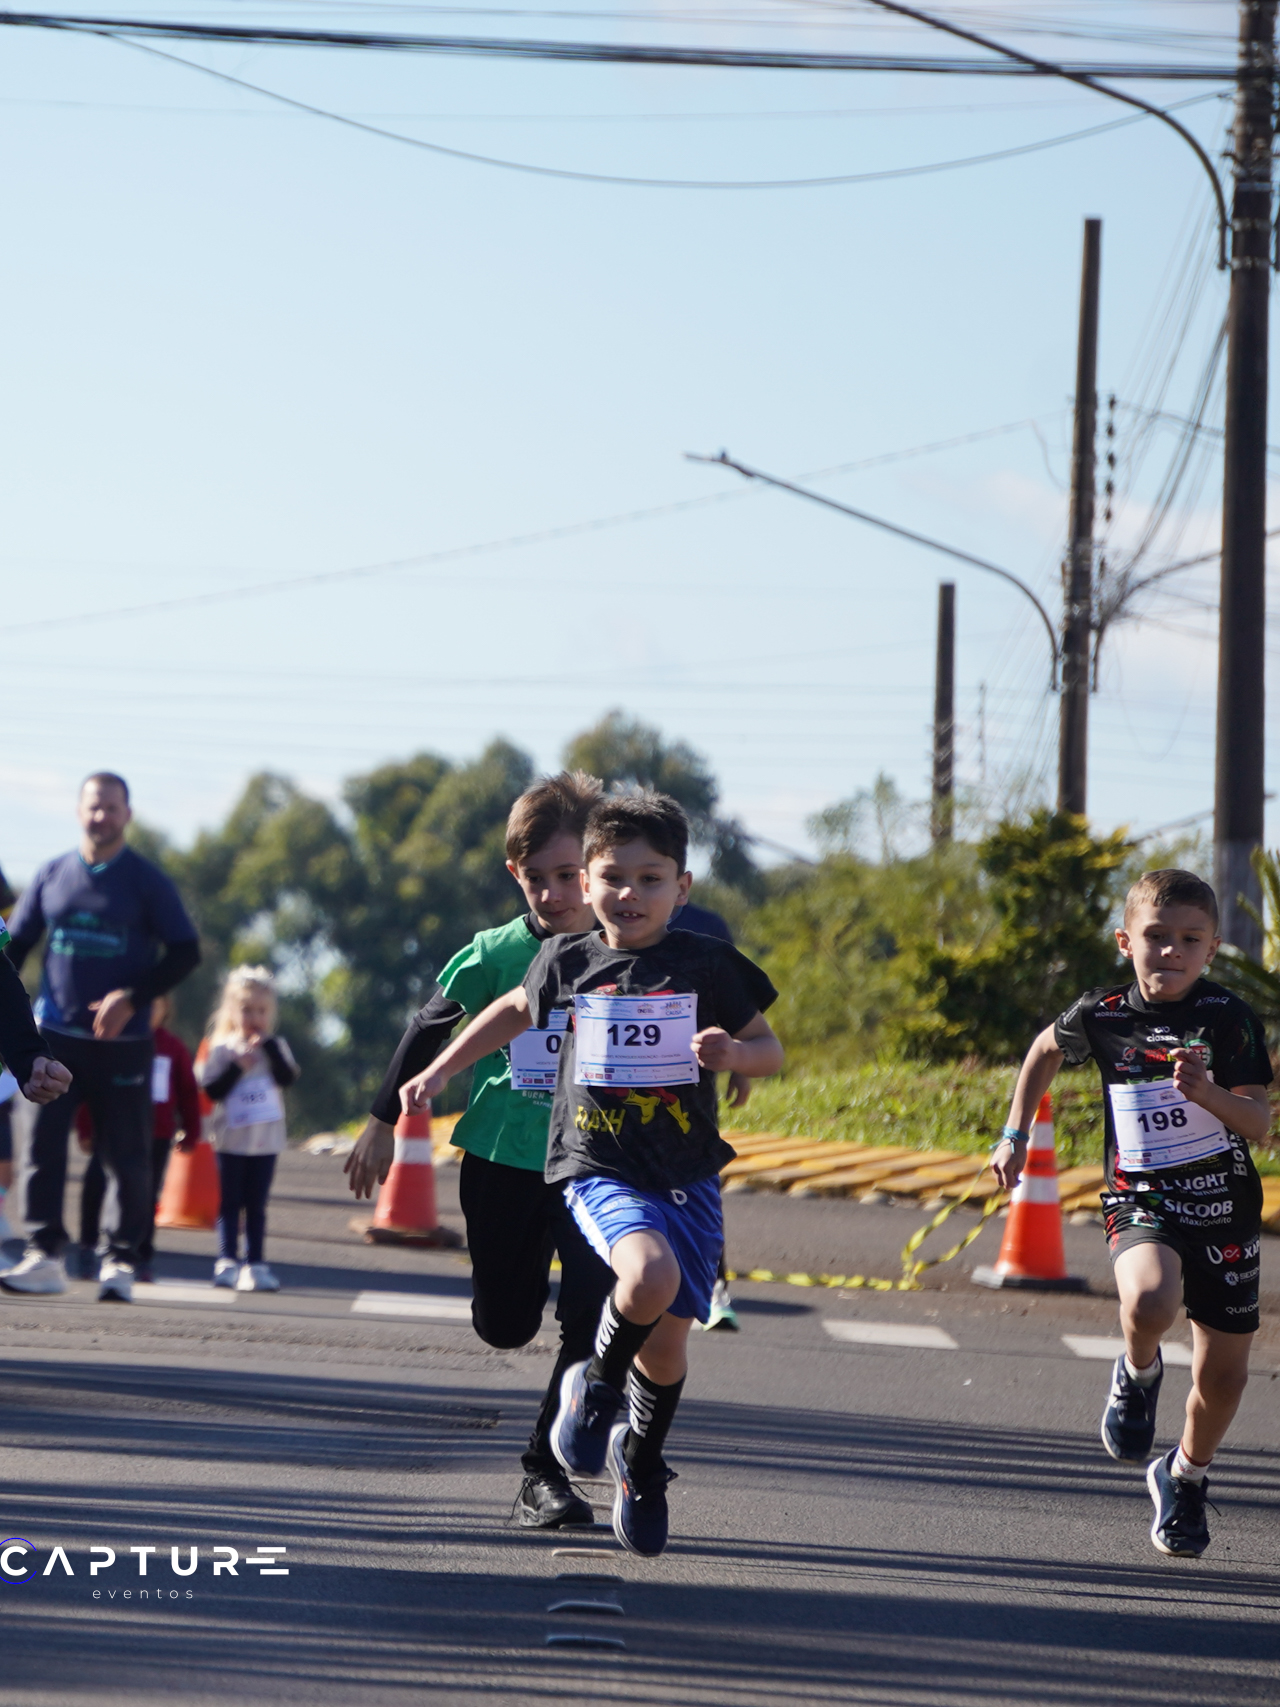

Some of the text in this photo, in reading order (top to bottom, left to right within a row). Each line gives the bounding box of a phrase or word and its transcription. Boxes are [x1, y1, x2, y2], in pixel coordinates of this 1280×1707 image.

[607, 1024, 661, 1047] 129
[1138, 1108, 1188, 1133] 198
[1164, 1198, 1234, 1218] SICOOB
[629, 1370, 657, 1438] RUN
